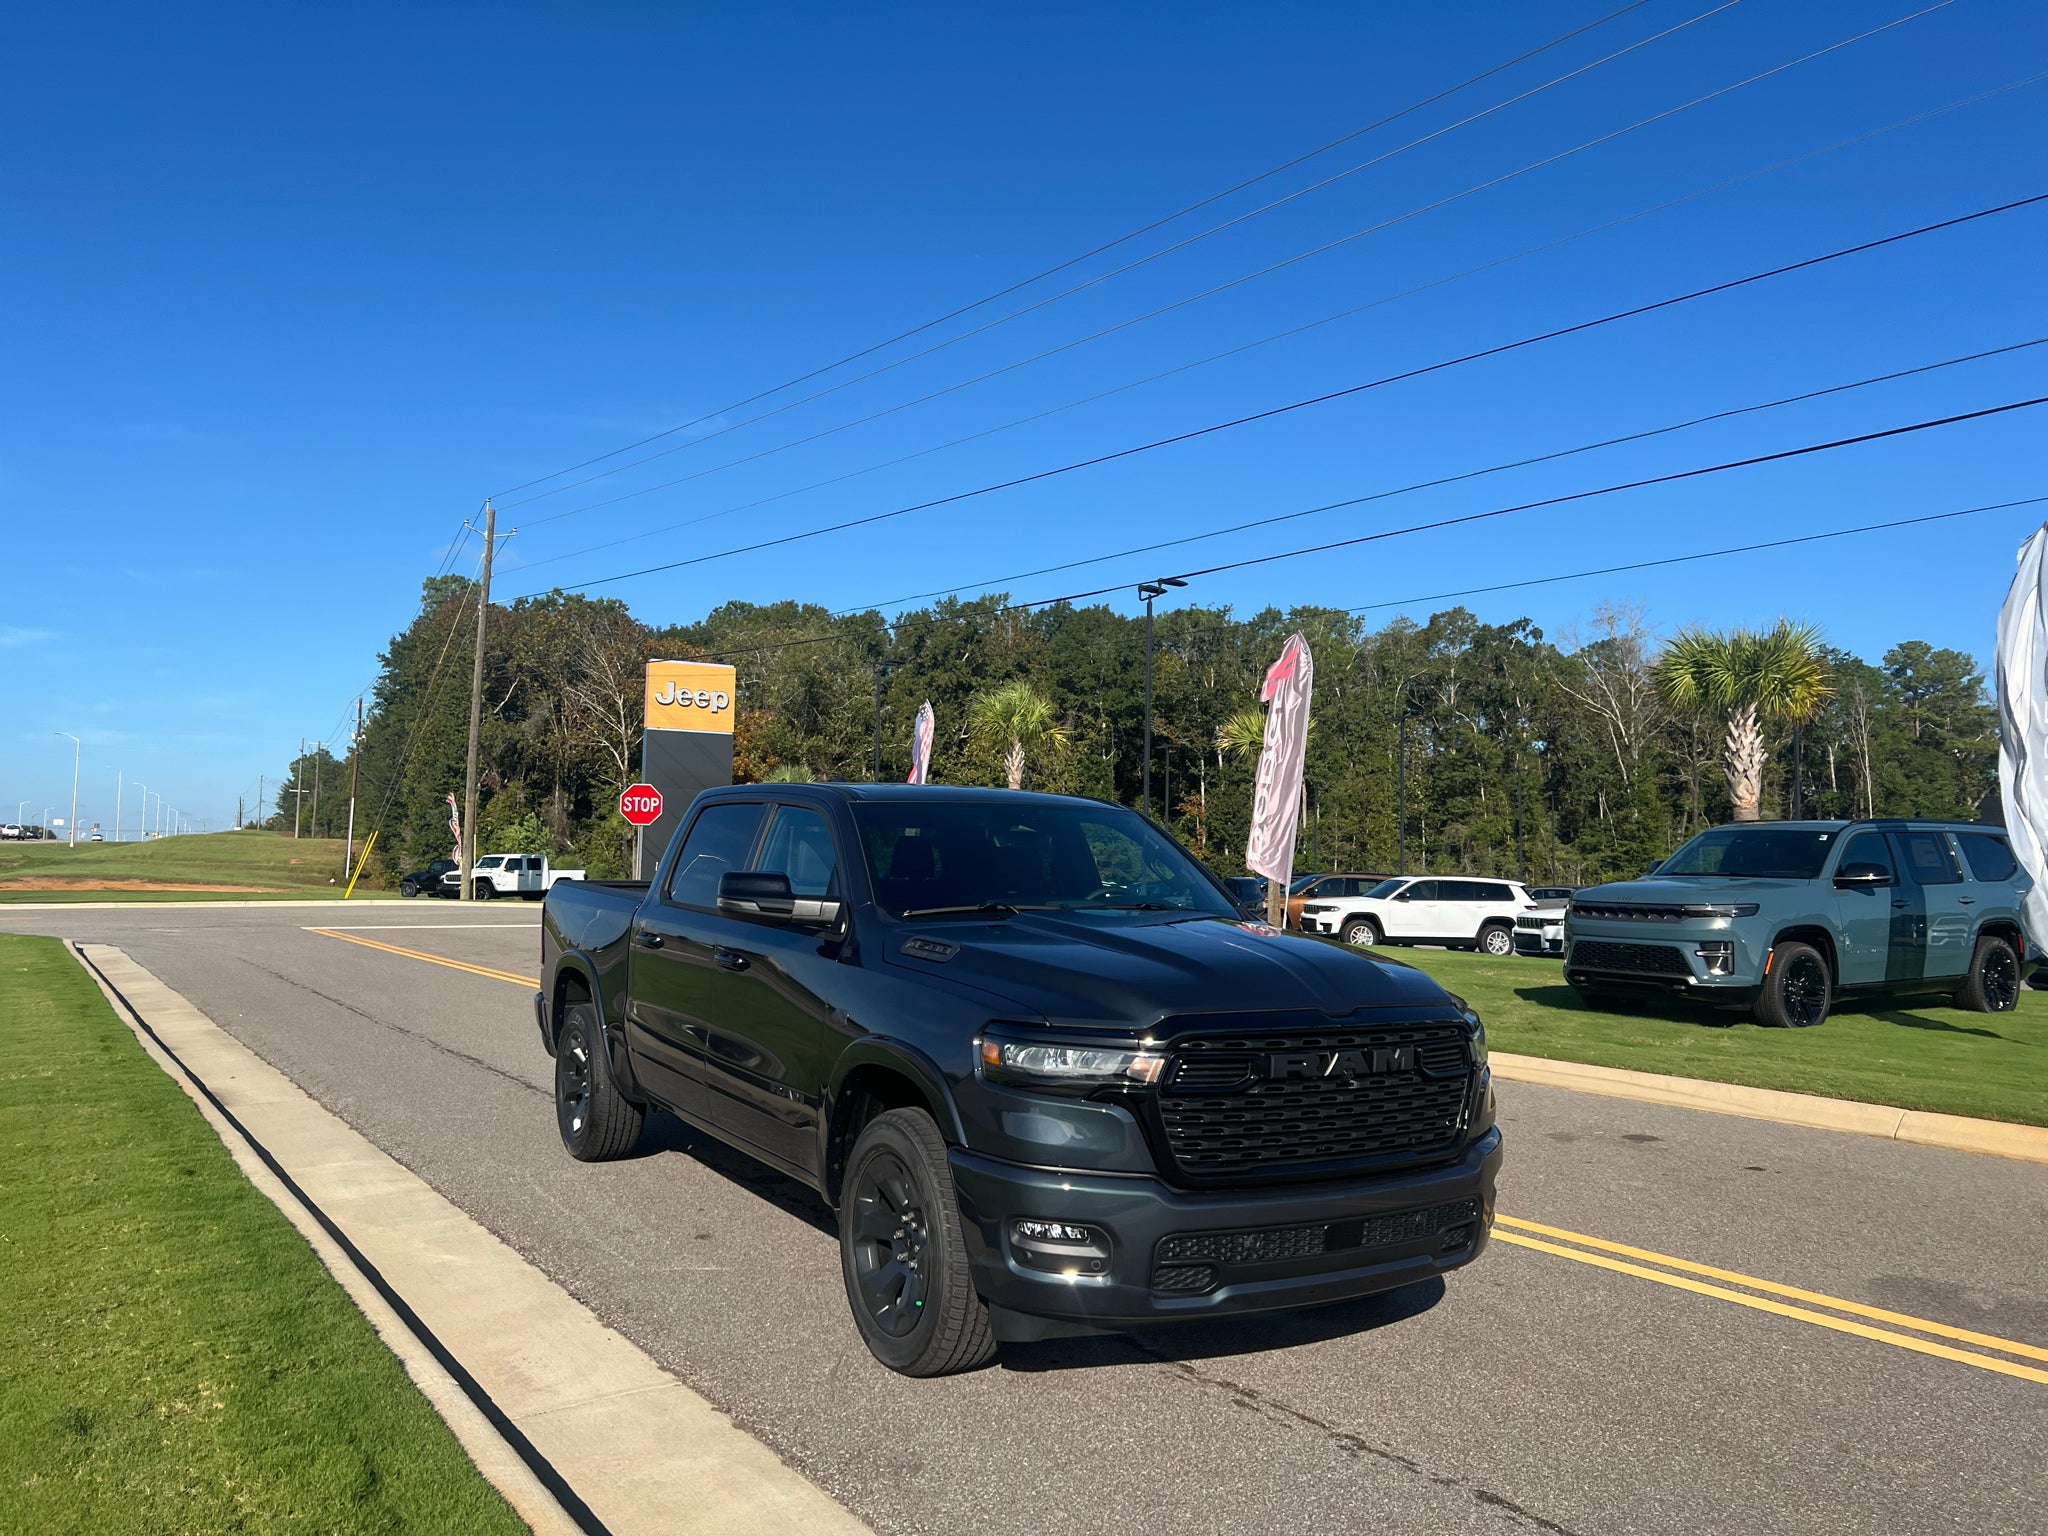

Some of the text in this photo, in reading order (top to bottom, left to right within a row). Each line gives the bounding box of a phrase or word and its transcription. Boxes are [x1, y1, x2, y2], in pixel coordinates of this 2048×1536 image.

[655, 681, 729, 713] Jeep
[623, 797, 660, 813] STOP
[1270, 1046, 1414, 1079] RAM
